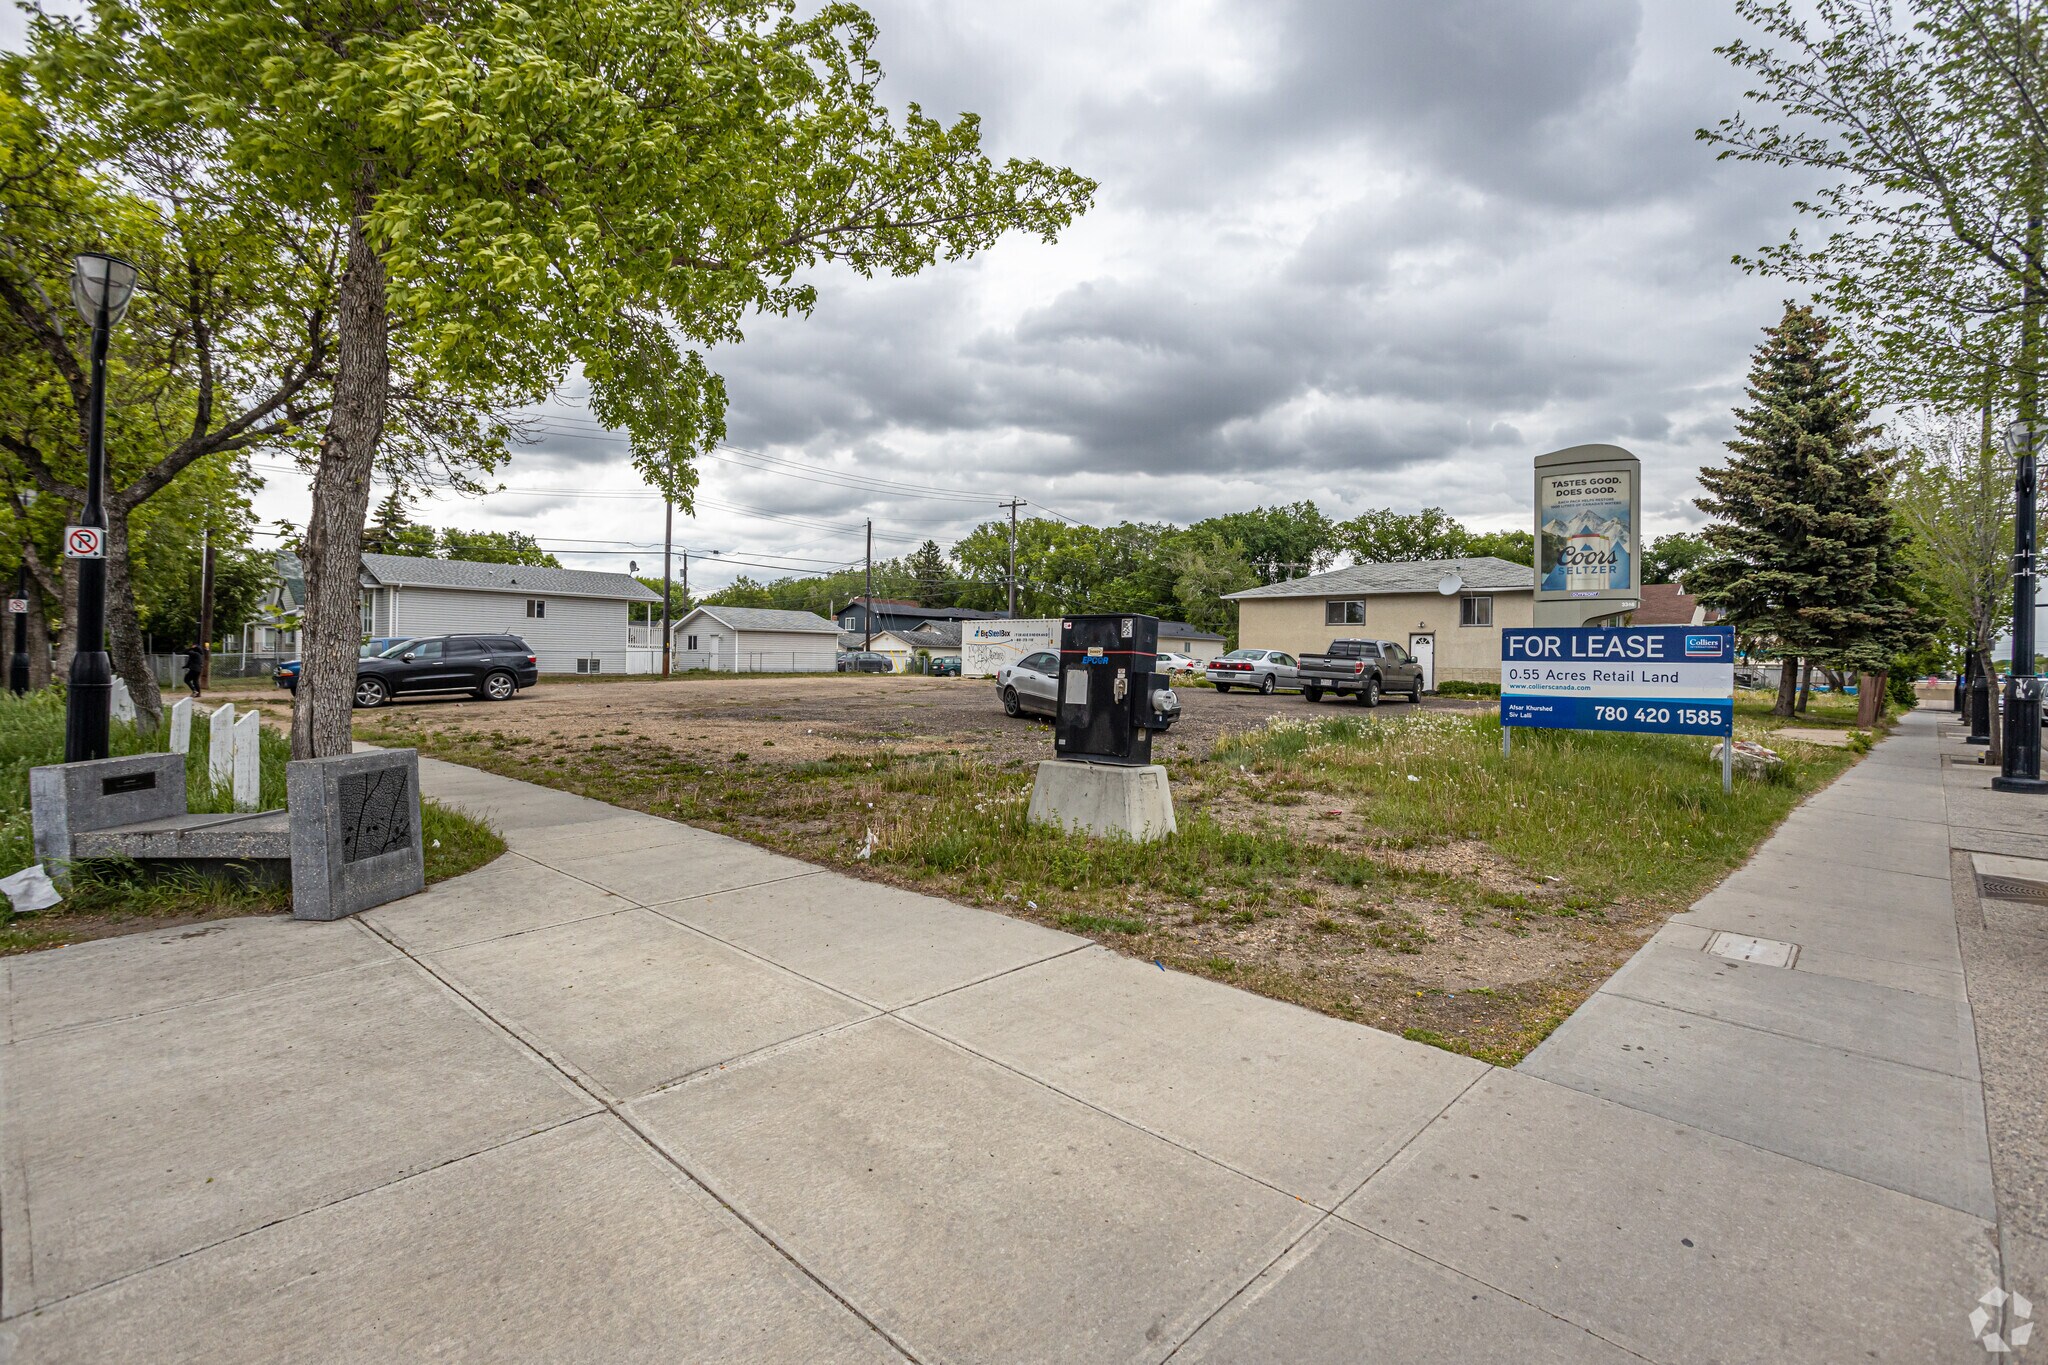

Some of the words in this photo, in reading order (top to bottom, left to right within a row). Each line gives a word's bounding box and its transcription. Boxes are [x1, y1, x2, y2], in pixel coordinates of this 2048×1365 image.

[1552, 479, 1587, 488] TASTES
[1589, 477, 1622, 485] GOOD.
[1556, 488, 1582, 497] DOES
[1557, 546, 1618, 566] Coors
[1558, 565, 1617, 575] SELTZER
[1509, 635, 1561, 657] FOR
[1571, 635, 1665, 658] LEASE
[1689, 638, 1719, 646] Colliers
[1081, 656, 1109, 665] EPCOR
[1509, 668, 1540, 680] 0.55
[1545, 669, 1586, 681] Acres
[1593, 669, 1635, 682] Retail
[1642, 670, 1679, 683] Land
[1509, 683, 1591, 691] www.collierscanada.com
[1594, 706, 1628, 721] 780
[1633, 707, 1670, 723] 420
[1677, 709, 1722, 725] 1585
